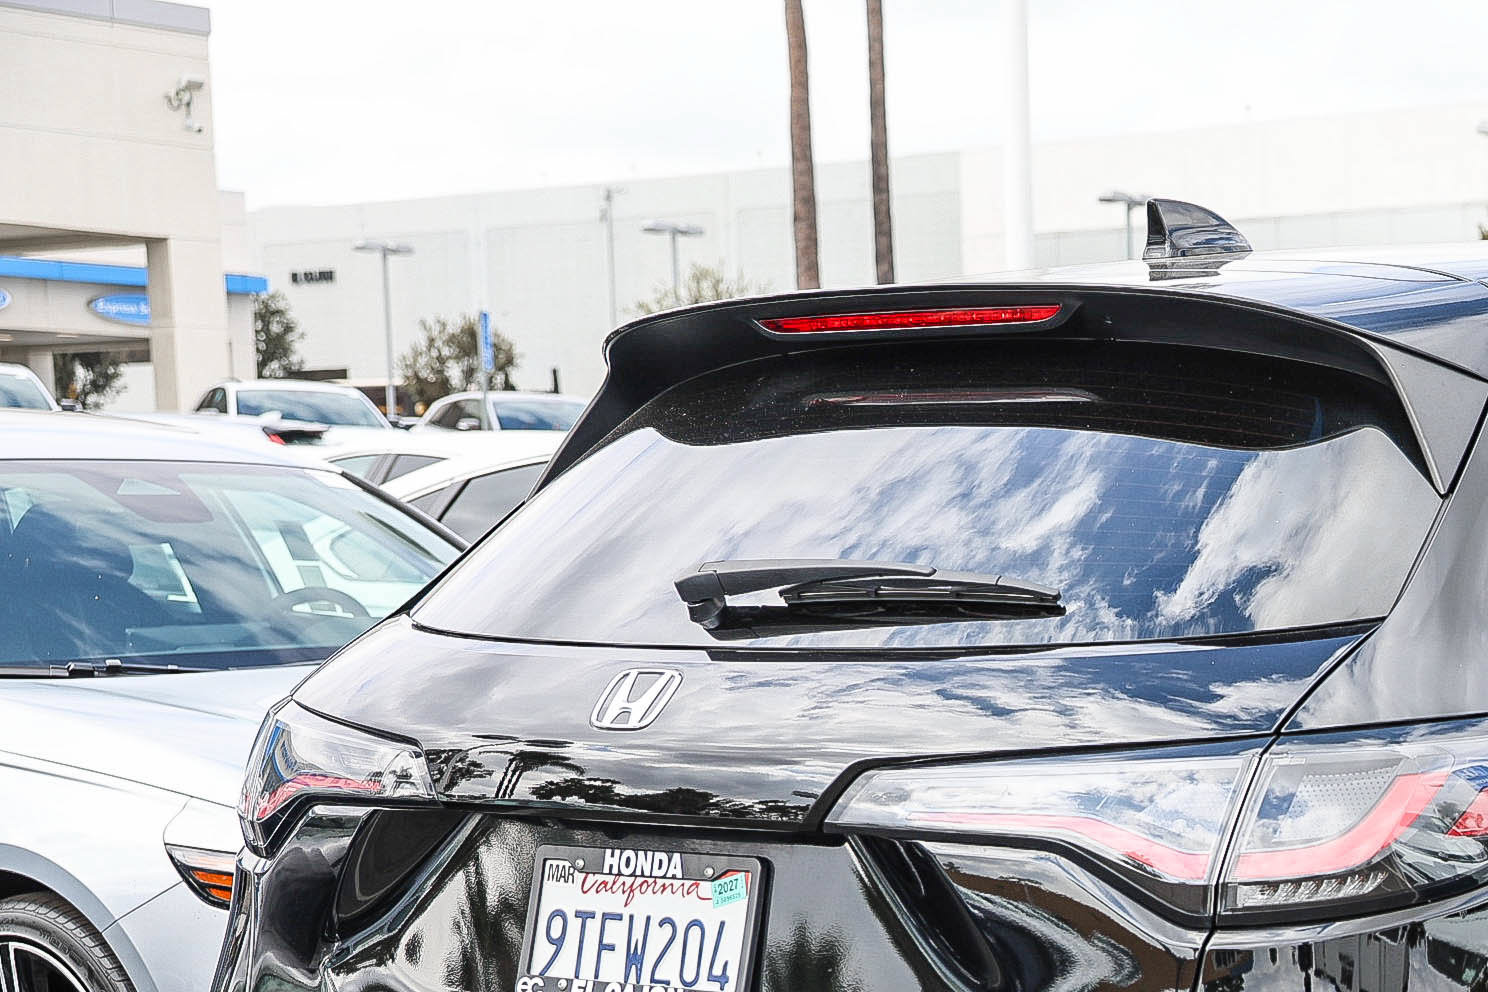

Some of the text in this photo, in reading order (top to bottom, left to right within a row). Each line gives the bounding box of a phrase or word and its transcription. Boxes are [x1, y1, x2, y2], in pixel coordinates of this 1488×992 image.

[547, 863, 576, 884] MAR
[602, 849, 683, 878] HONDA
[580, 872, 713, 908] California
[717, 878, 739, 896] 2027
[539, 908, 730, 991] 9TFW204
